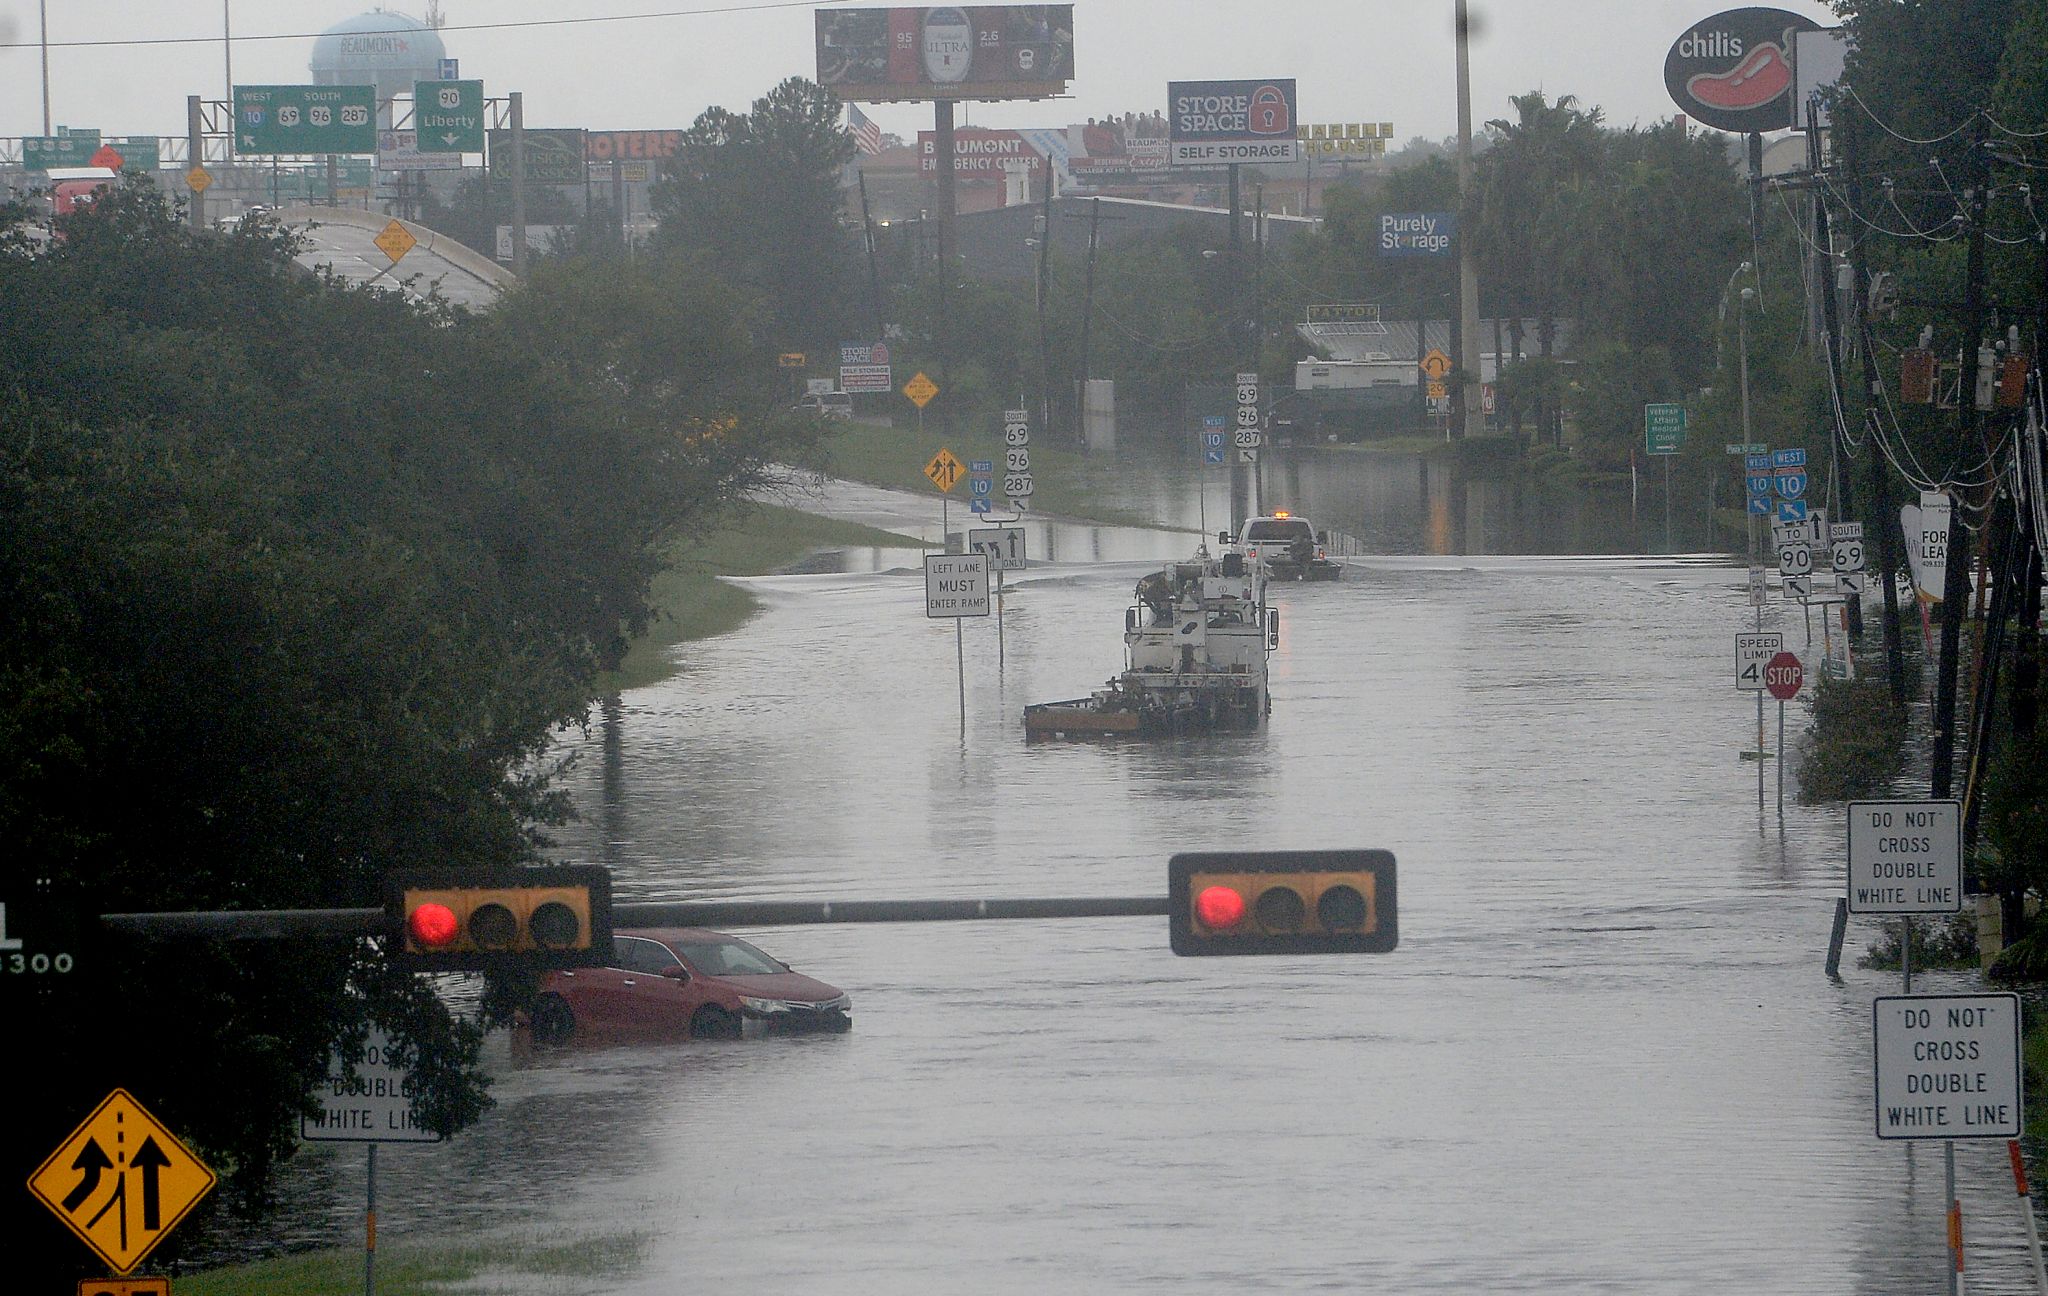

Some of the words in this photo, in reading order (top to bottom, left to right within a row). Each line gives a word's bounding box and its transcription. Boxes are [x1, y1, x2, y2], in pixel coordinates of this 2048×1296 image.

[896, 32, 913, 43] 95
[980, 31, 999, 41] 2.6
[340, 38, 399, 53] BEAUMONT
[1678, 31, 1743, 58] chilis
[241, 92, 272, 101] WEST
[304, 92, 341, 101] SOUTH
[441, 92, 458, 103] 90
[1177, 95, 1248, 114] STORE
[247, 111, 261, 123] 10
[281, 110, 298, 122] 69
[312, 110, 330, 122] 96
[342, 109, 366, 122] 287
[424, 115, 475, 128] Liberty
[1179, 113, 1246, 132] SPACE
[1297, 125, 1391, 138] WAFFLE
[924, 139, 1022, 154] BUMONT
[1127, 139, 1170, 147] BEAUMON
[1307, 141, 1383, 152] HOUSE
[1179, 146, 1214, 159] SELF
[1218, 144, 1290, 158] STORAGE
[922, 157, 992, 171] EMGENCY
[1381, 214, 1436, 235] Purely
[1309, 306, 1378, 317] TATTOO
[841, 347, 871, 355] STORE
[842, 355, 871, 363] SPACE
[1239, 388, 1256, 400] 69
[1430, 383, 1443, 393] 20
[1006, 412, 1028, 420] SOUTH
[1239, 410, 1256, 421] 96
[1007, 428, 1026, 441] 69
[1208, 434, 1220, 446] 10
[1236, 431, 1260, 444] 287
[1008, 454, 1027, 467] 96
[1749, 458, 1769, 467] WEST
[1777, 452, 1801, 463] WEST
[972, 463, 990, 471] WEST
[974, 481, 988, 493] 10
[1005, 478, 1032, 491] 287
[1751, 478, 1767, 490] 10
[1780, 476, 1799, 493] 10
[1785, 529, 1800, 539] TO
[1832, 525, 1860, 536] SOUTH
[1921, 530, 1947, 543] FOR
[1782, 550, 1809, 567] 90
[1835, 547, 1861, 566] 69
[1921, 545, 1945, 559] LEA
[932, 563, 953, 574] LEFT
[958, 563, 981, 573] LANE
[1004, 559, 1024, 568] ONLY
[938, 579, 975, 592] MUST
[930, 598, 957, 609] ENTER
[961, 598, 986, 608] RAMP
[1739, 638, 1779, 648] SPEED
[1743, 650, 1775, 660] LIMIT
[1741, 662, 1767, 683] 4
[1767, 667, 1801, 685] STOP
[1872, 812, 1892, 828] DO
[1905, 811, 1936, 827] NOT
[1879, 837, 1930, 853] CROSS
[1873, 862, 1936, 878] DOUBLE
[1857, 888, 1905, 903] WHITE
[1917, 887, 1952, 903] LINE
[0, 952, 74, 974] 300
[1905, 1009, 1930, 1029] DO
[1948, 1008, 1987, 1028] NOT
[1914, 1040, 1979, 1061] CROSS
[1907, 1073, 1987, 1093] DOUBLE
[389, 1109, 420, 1129] LIN
[1887, 1106, 1950, 1126] WHITE
[1964, 1105, 2009, 1125] LINE
